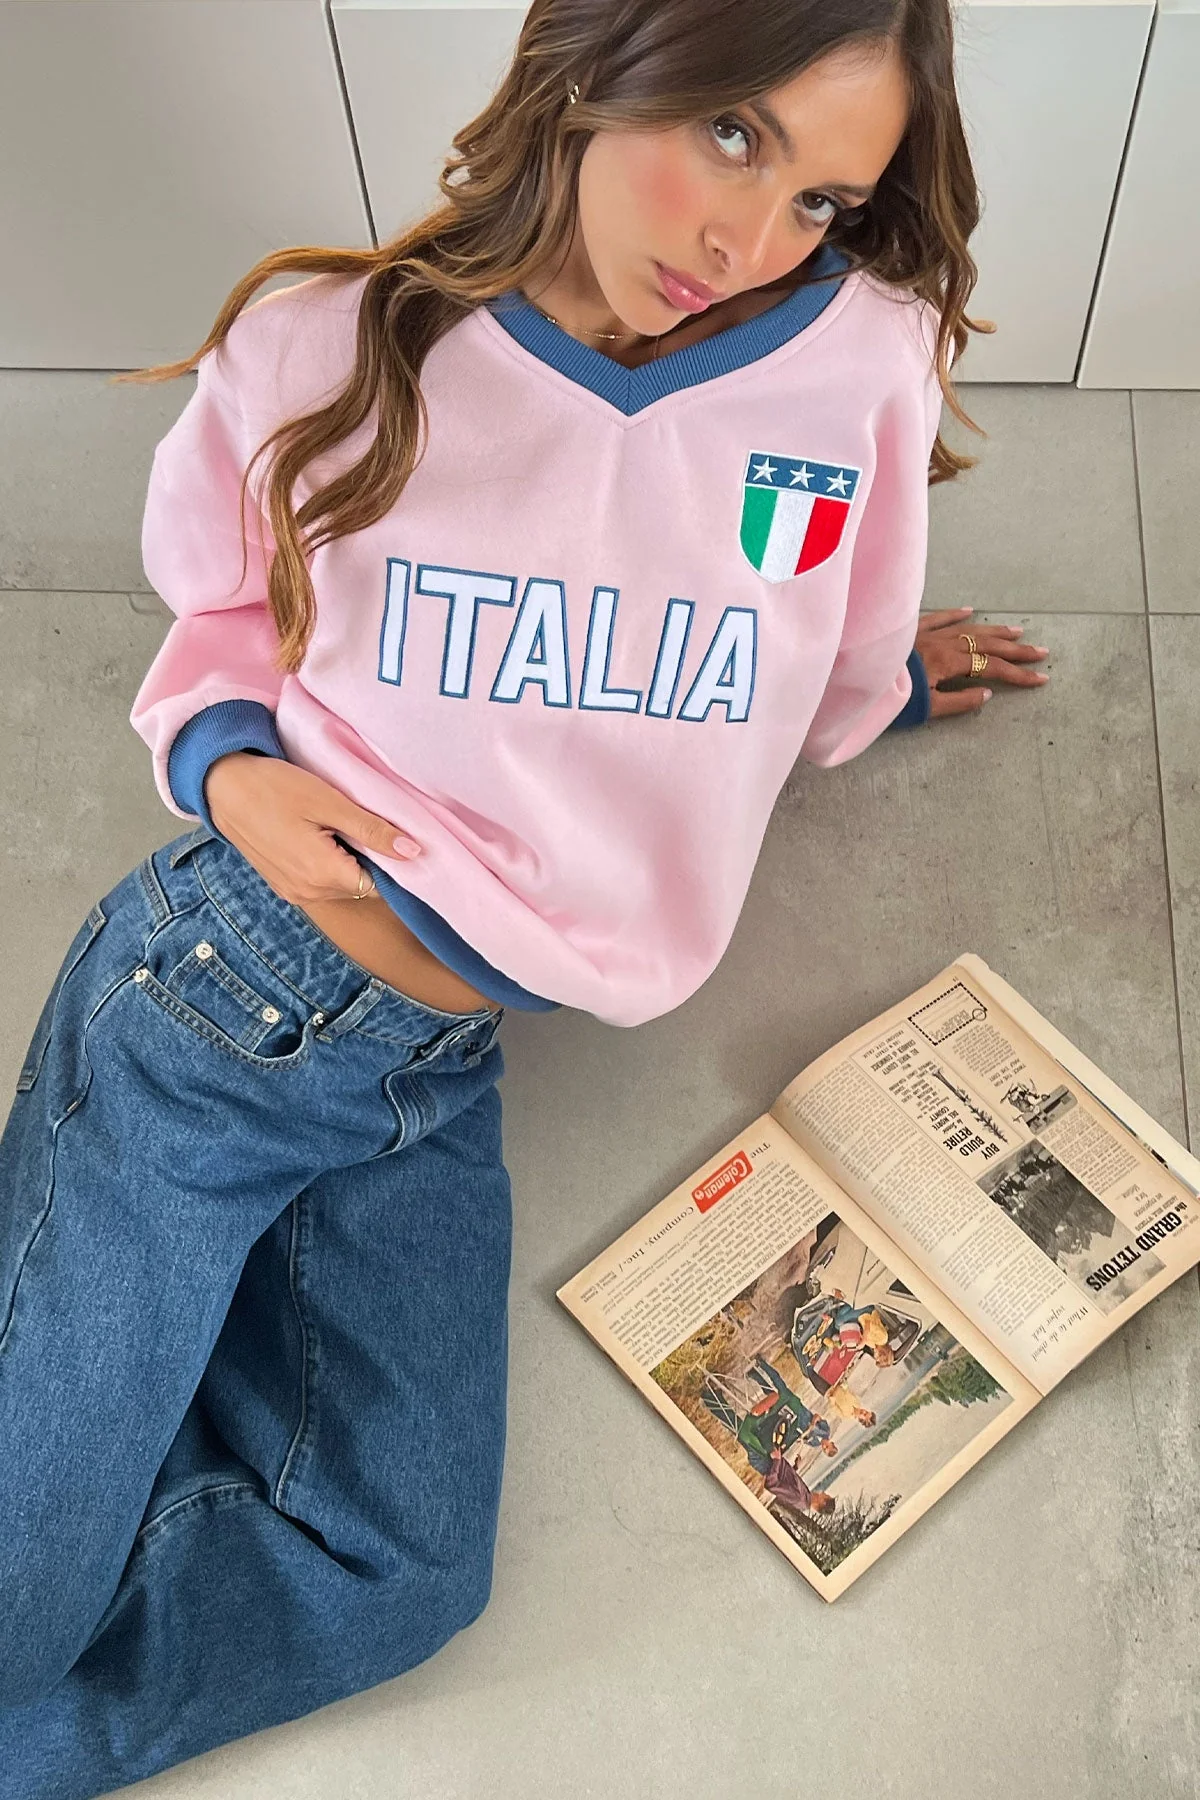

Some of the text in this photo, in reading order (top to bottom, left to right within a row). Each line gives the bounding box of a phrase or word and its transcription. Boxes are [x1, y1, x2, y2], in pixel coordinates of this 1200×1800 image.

[378, 557, 757, 722] ITALIA
[929, 1105, 949, 1122] COUNTY
[931, 1109, 959, 1130] DEL NORTE
[942, 1126, 972, 1150] RETIRE
[959, 1135, 985, 1156] BUILD
[750, 1141, 771, 1159] The
[980, 1142, 1000, 1160] BUY
[701, 1157, 749, 1200] Coleman
[1174, 1201, 1187, 1213] the
[1135, 1211, 1182, 1251] GRAND
[623, 1247, 644, 1266] Inc.
[1085, 1245, 1141, 1291] TETONS
[1066, 1306, 1088, 1326] What
[1048, 1331, 1060, 1343] do
[1059, 1323, 1067, 1332] to
